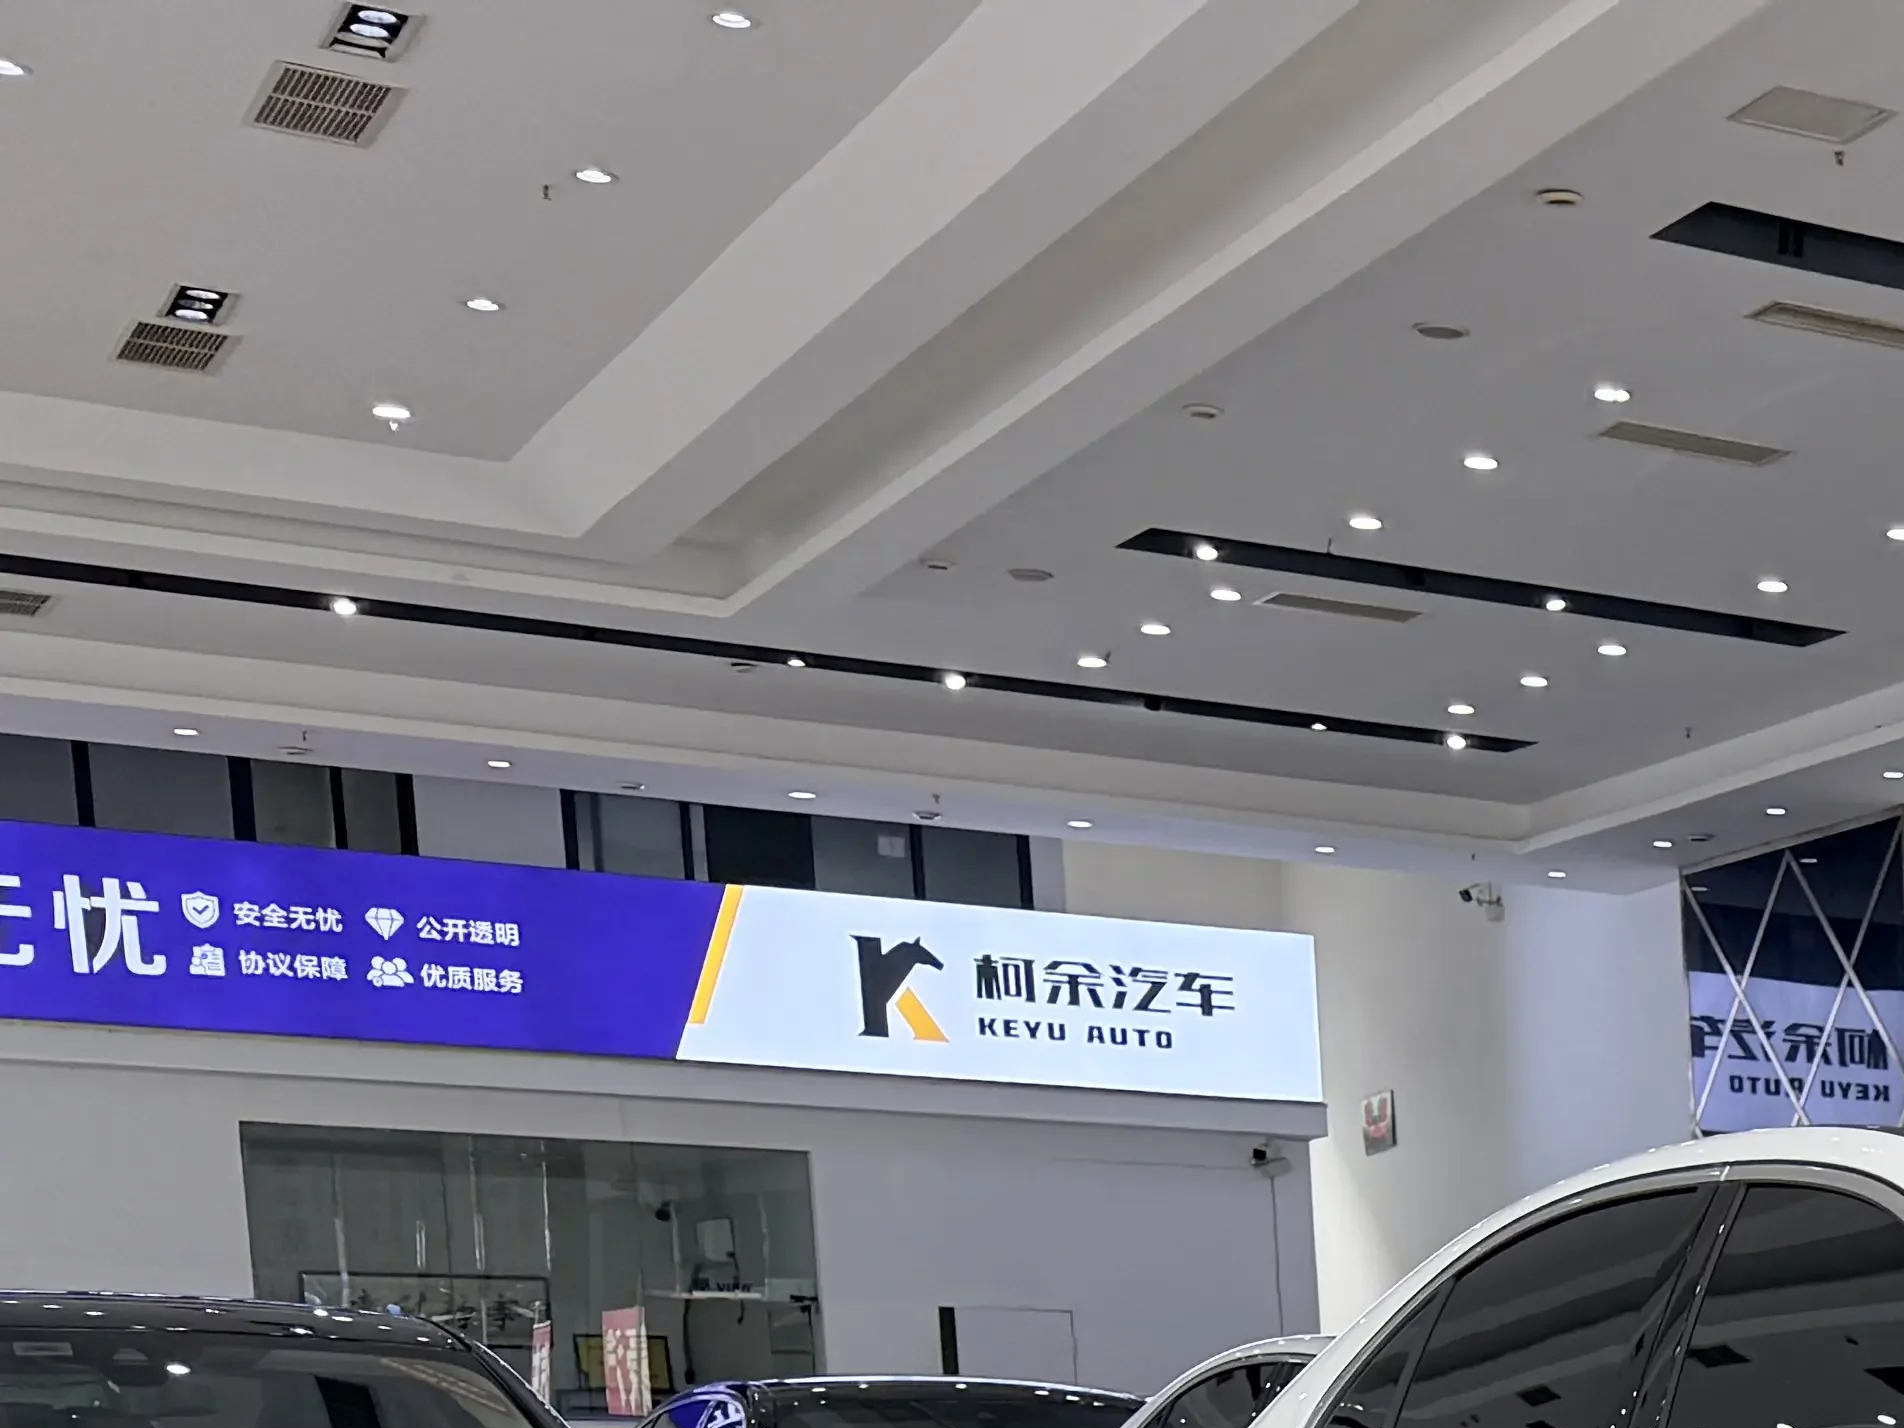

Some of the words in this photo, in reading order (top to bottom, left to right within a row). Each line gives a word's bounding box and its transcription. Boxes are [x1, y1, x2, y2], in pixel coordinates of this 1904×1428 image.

[233, 901, 343, 933] 安全无忧
[416, 916, 520, 947] 公开透明
[239, 950, 348, 981] 协议保障
[421, 964, 524, 995] 优质服务
[973, 953, 1236, 1017] 柯余汽车
[977, 1017, 1067, 1043] KEYU
[1086, 1025, 1173, 1050] AUTO
